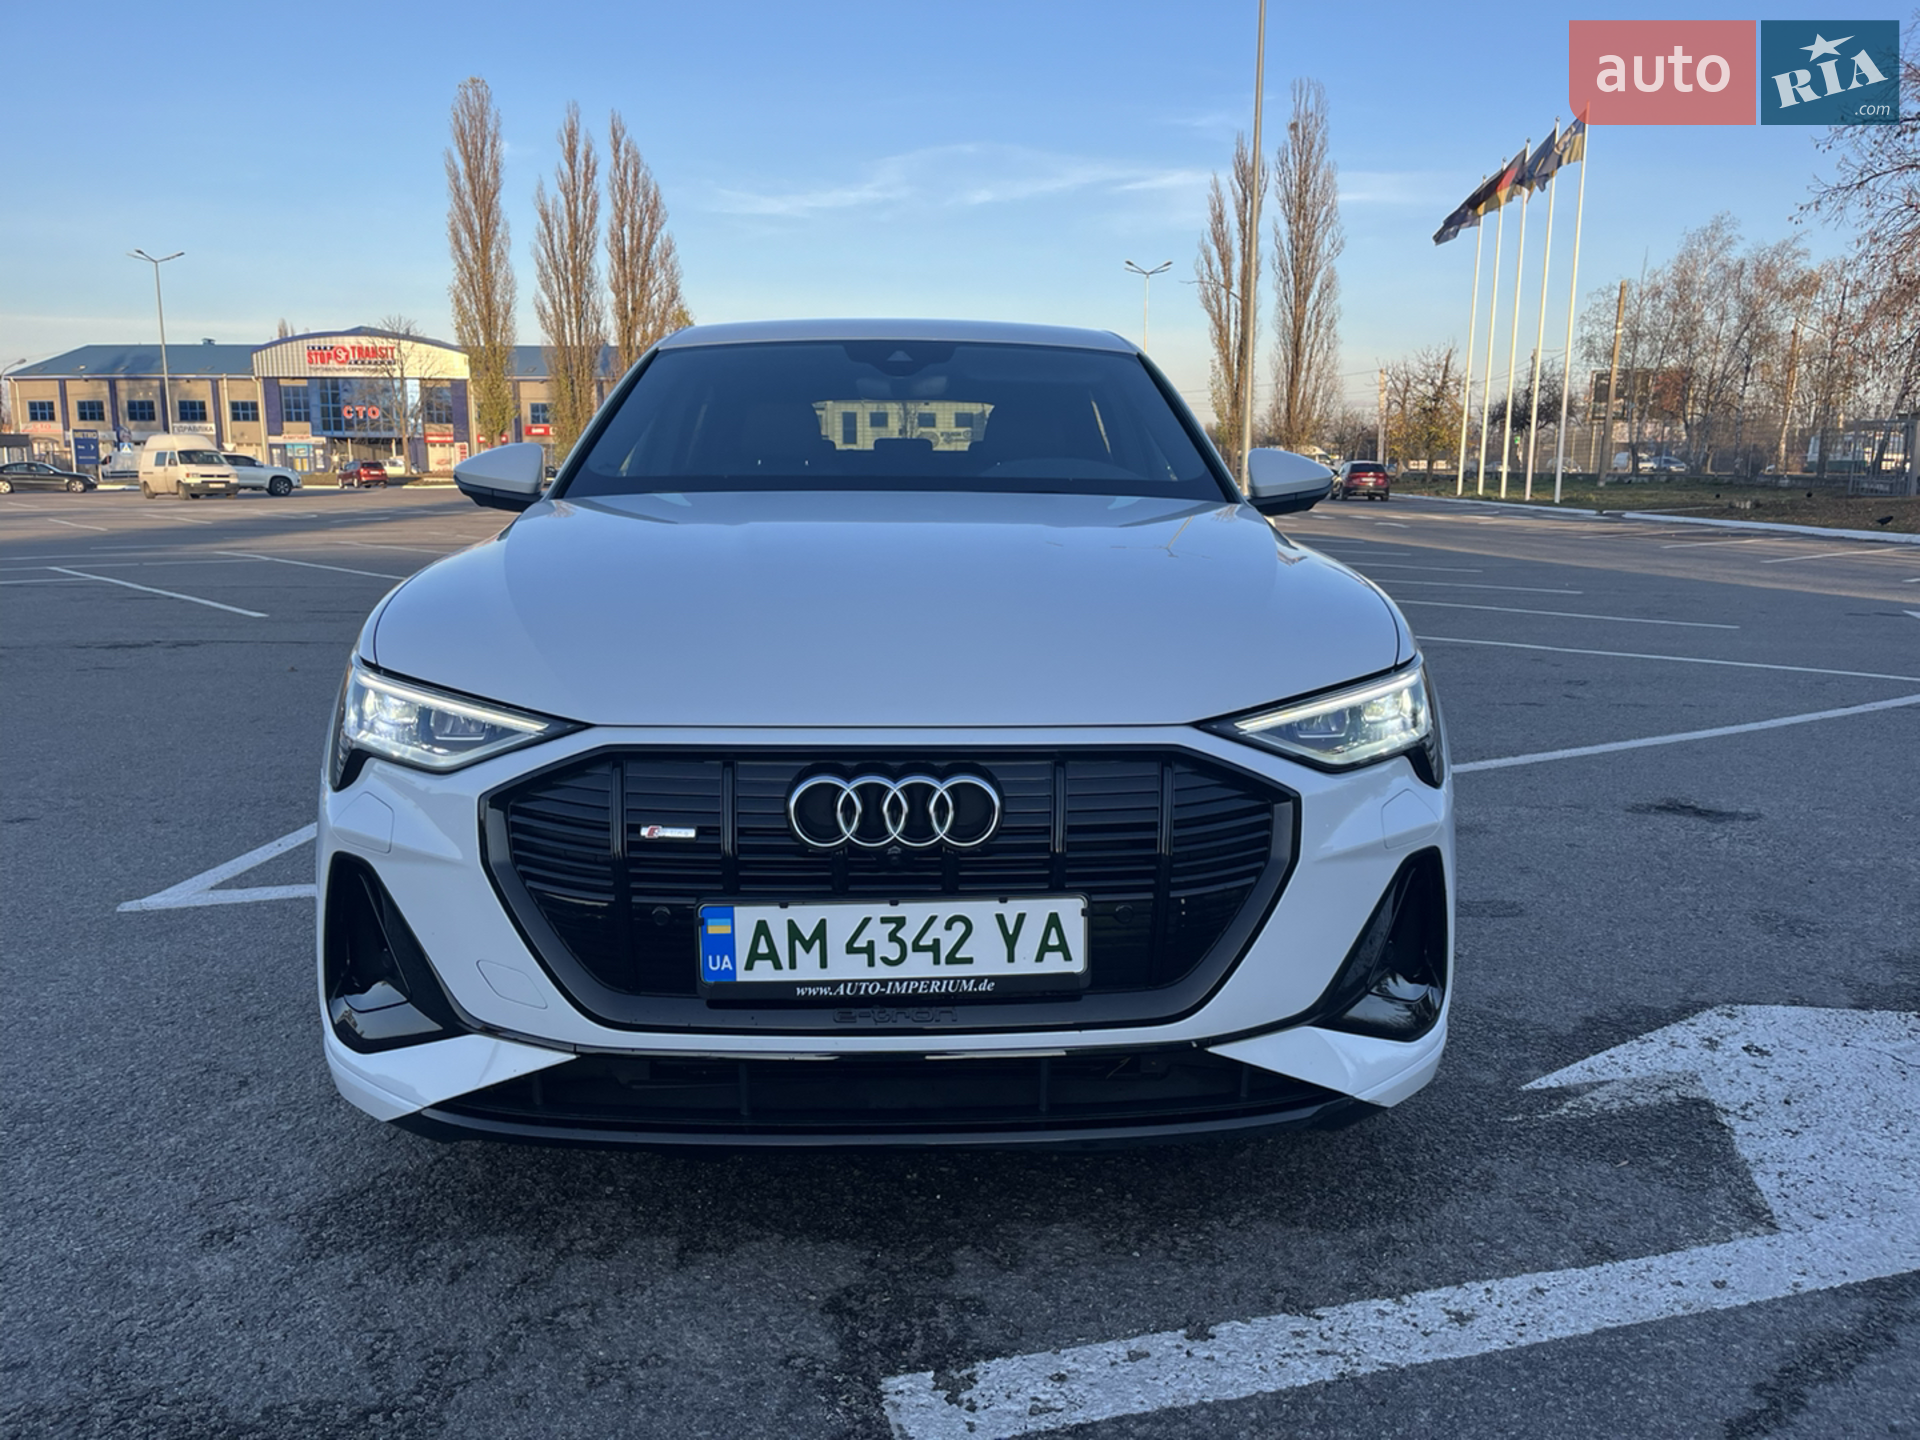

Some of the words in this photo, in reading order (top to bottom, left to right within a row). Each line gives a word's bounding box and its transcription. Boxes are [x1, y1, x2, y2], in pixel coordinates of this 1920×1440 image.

[307, 350, 333, 365] STOP
[350, 345, 396, 360] TRANSIT
[343, 405, 380, 419] СТО
[743, 917, 828, 971] AM
[845, 914, 975, 968] 4342
[994, 911, 1073, 964] YA
[708, 954, 733, 971] UA
[795, 978, 995, 996] www.AUTO-IMPERIUM.de
